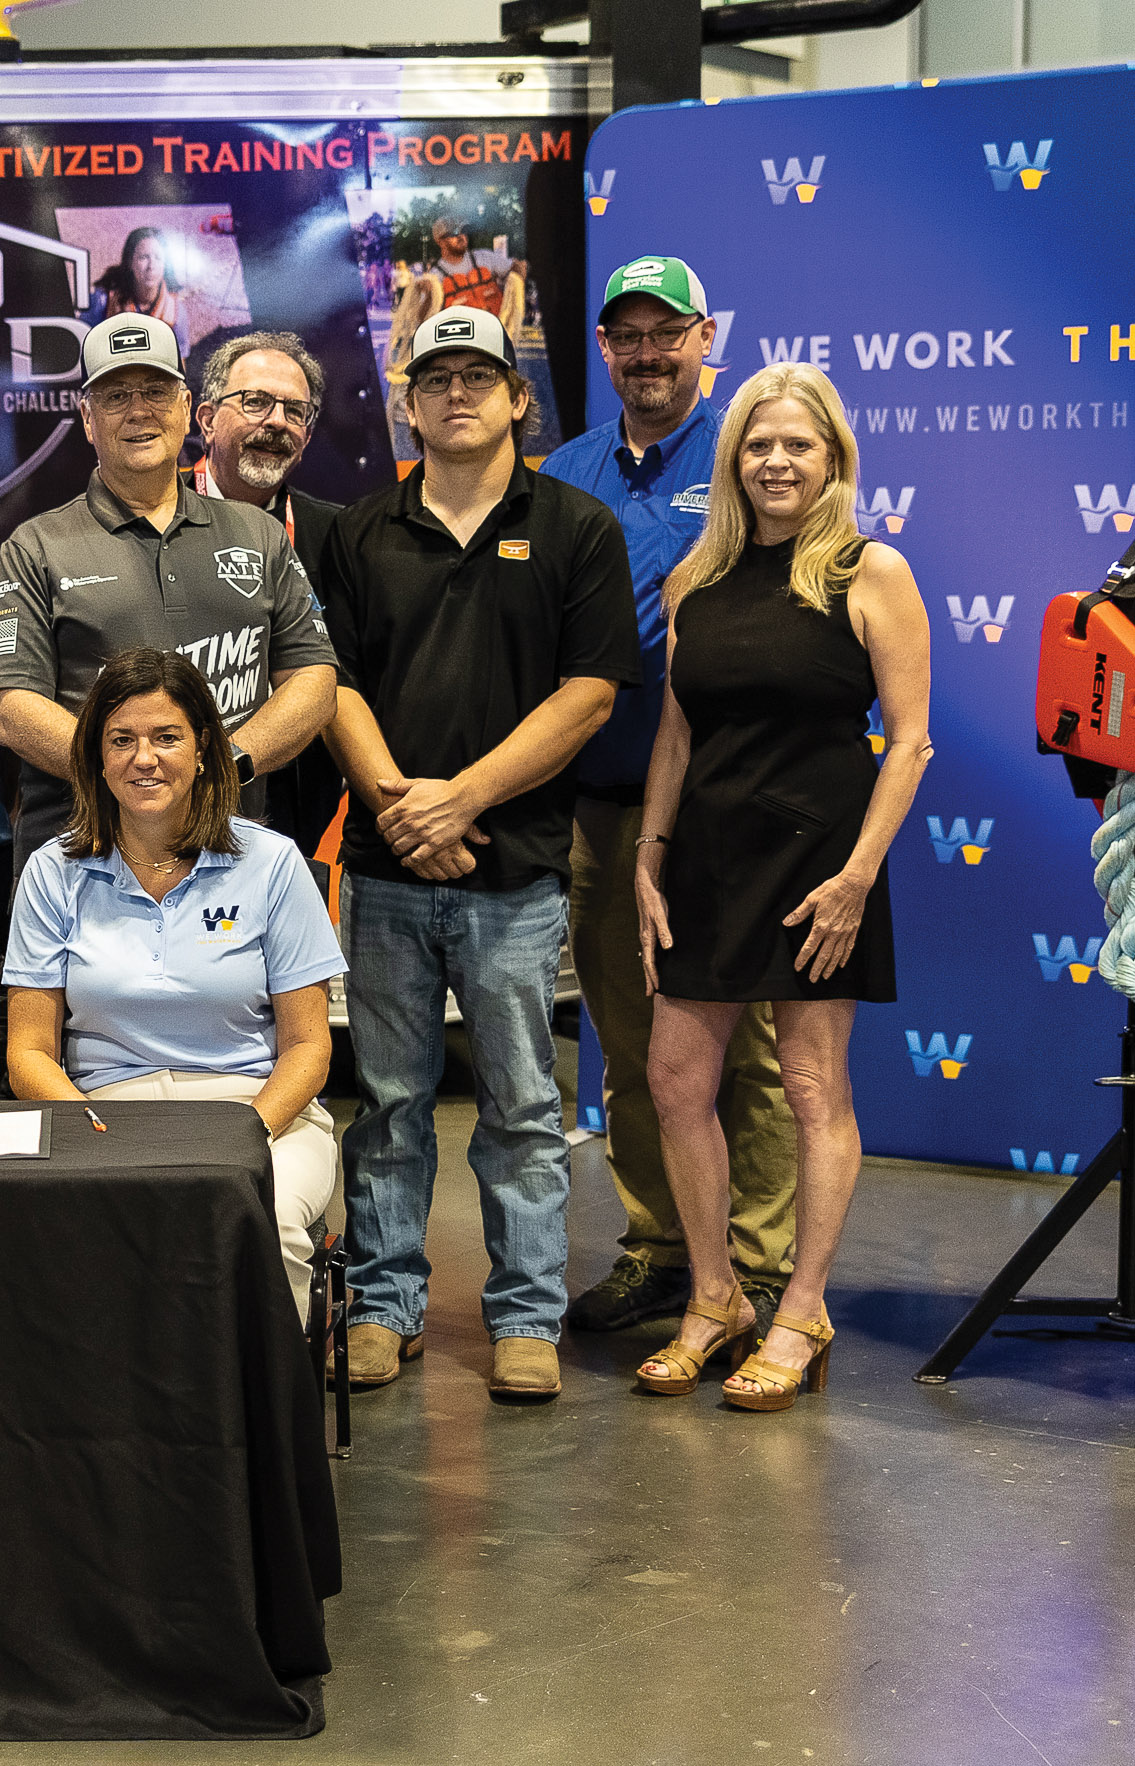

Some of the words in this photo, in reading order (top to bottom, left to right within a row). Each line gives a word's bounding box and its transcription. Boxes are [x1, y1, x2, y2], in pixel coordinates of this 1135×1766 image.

[153, 135, 353, 174] TRAINING
[367, 130, 572, 166] PROGRAM
[759, 335, 831, 372] WE
[853, 328, 1015, 371] WORK
[1090, 652, 1107, 736] KENT
